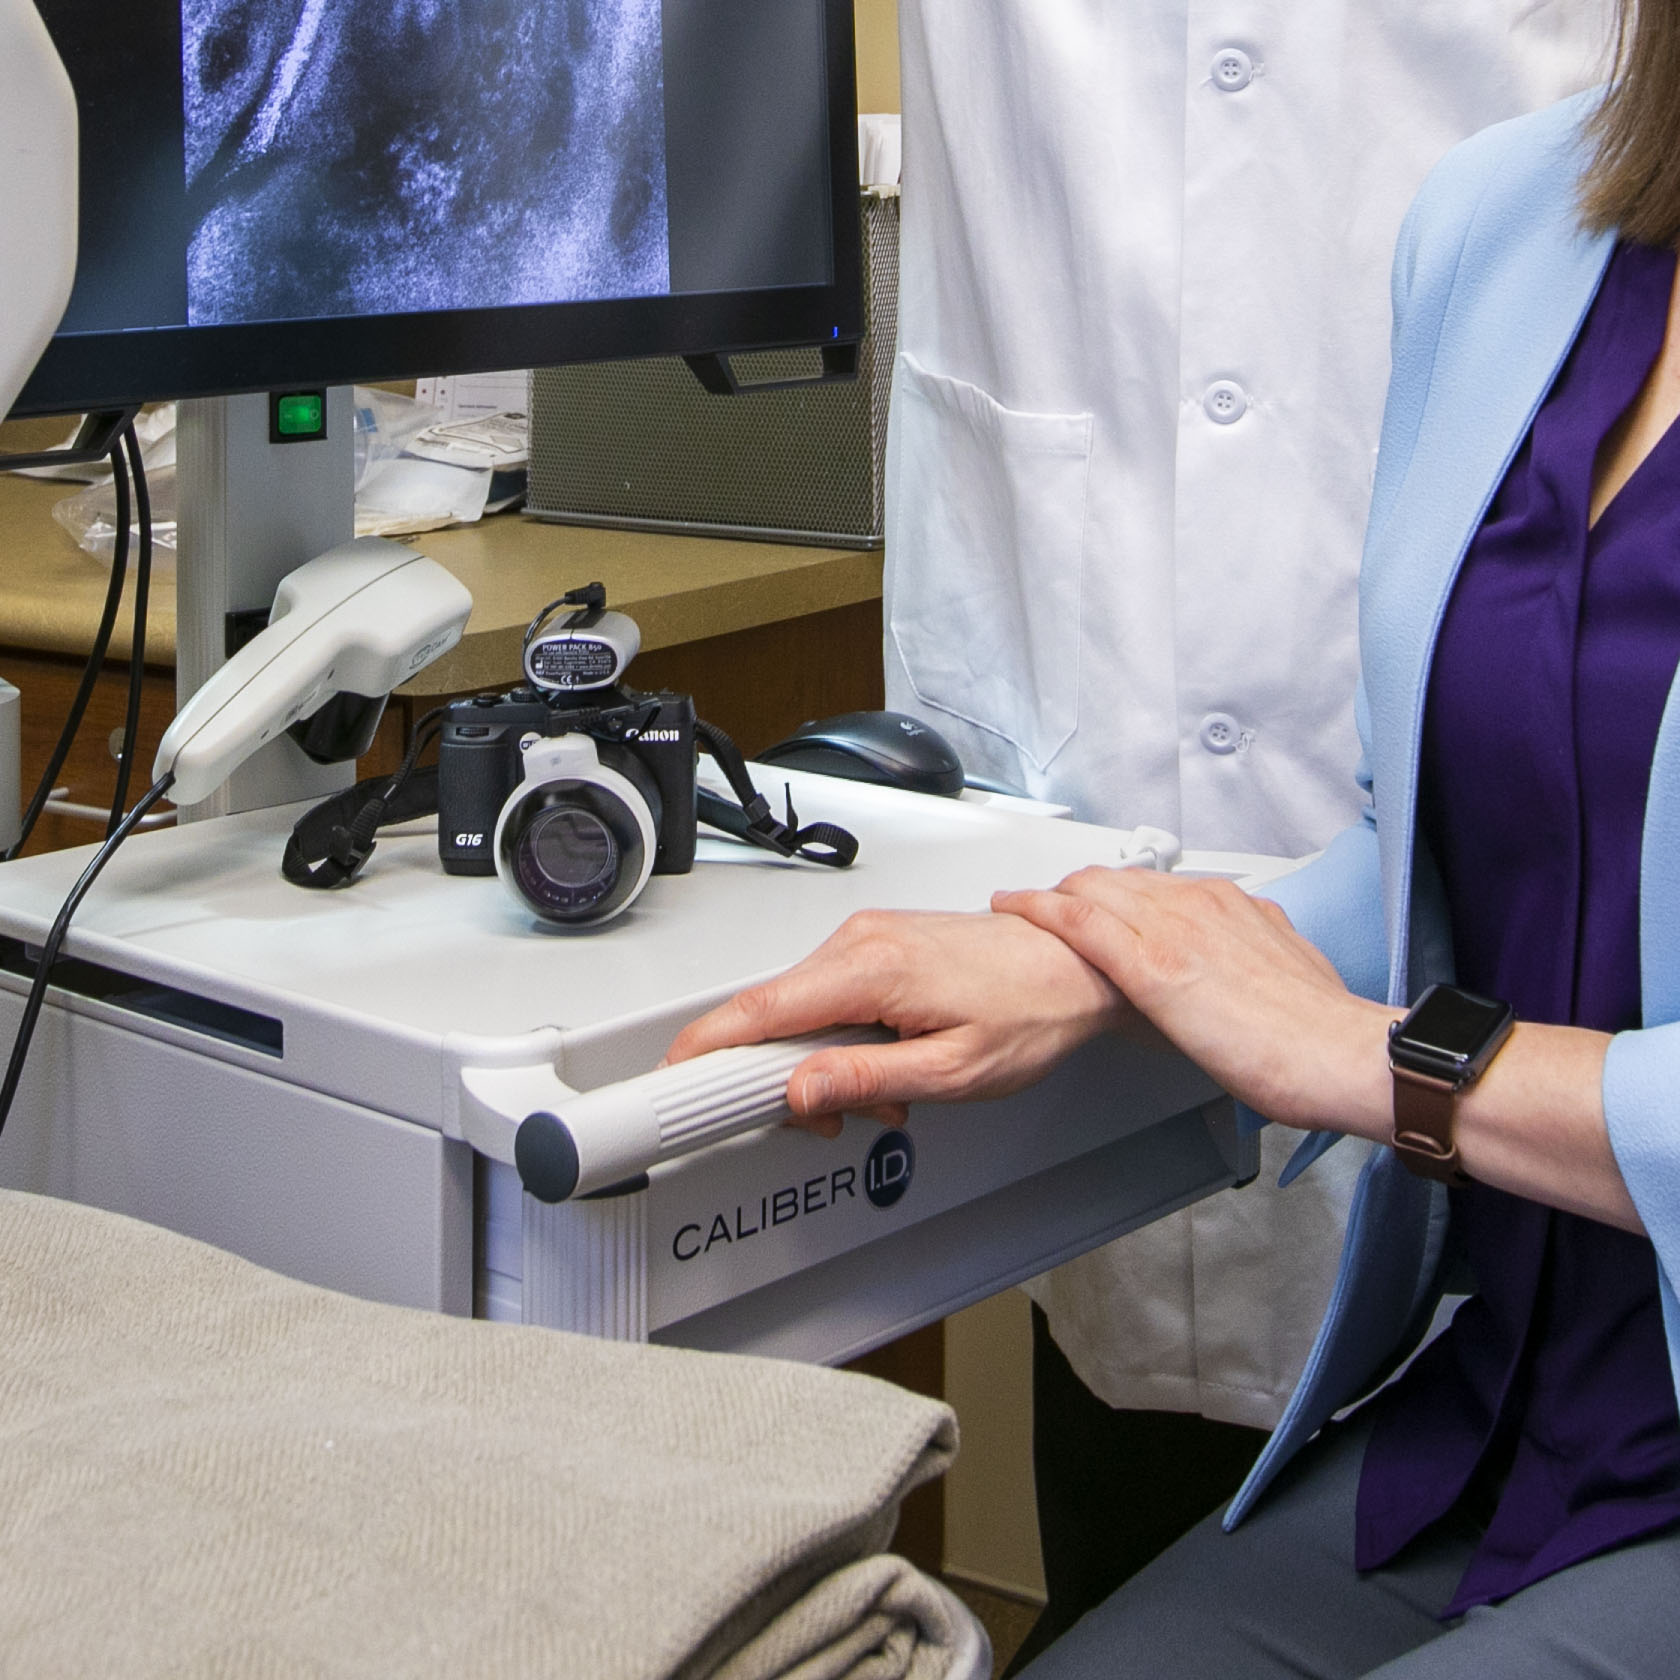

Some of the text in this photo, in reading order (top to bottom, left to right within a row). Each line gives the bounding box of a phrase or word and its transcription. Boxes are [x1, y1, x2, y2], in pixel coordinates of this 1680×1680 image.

[542, 643, 567, 652] POWER
[569, 643, 586, 651] PACK
[625, 728, 679, 742] Canon
[455, 833, 483, 846] G16
[672, 1149, 910, 1261] CALIBER I.D.
